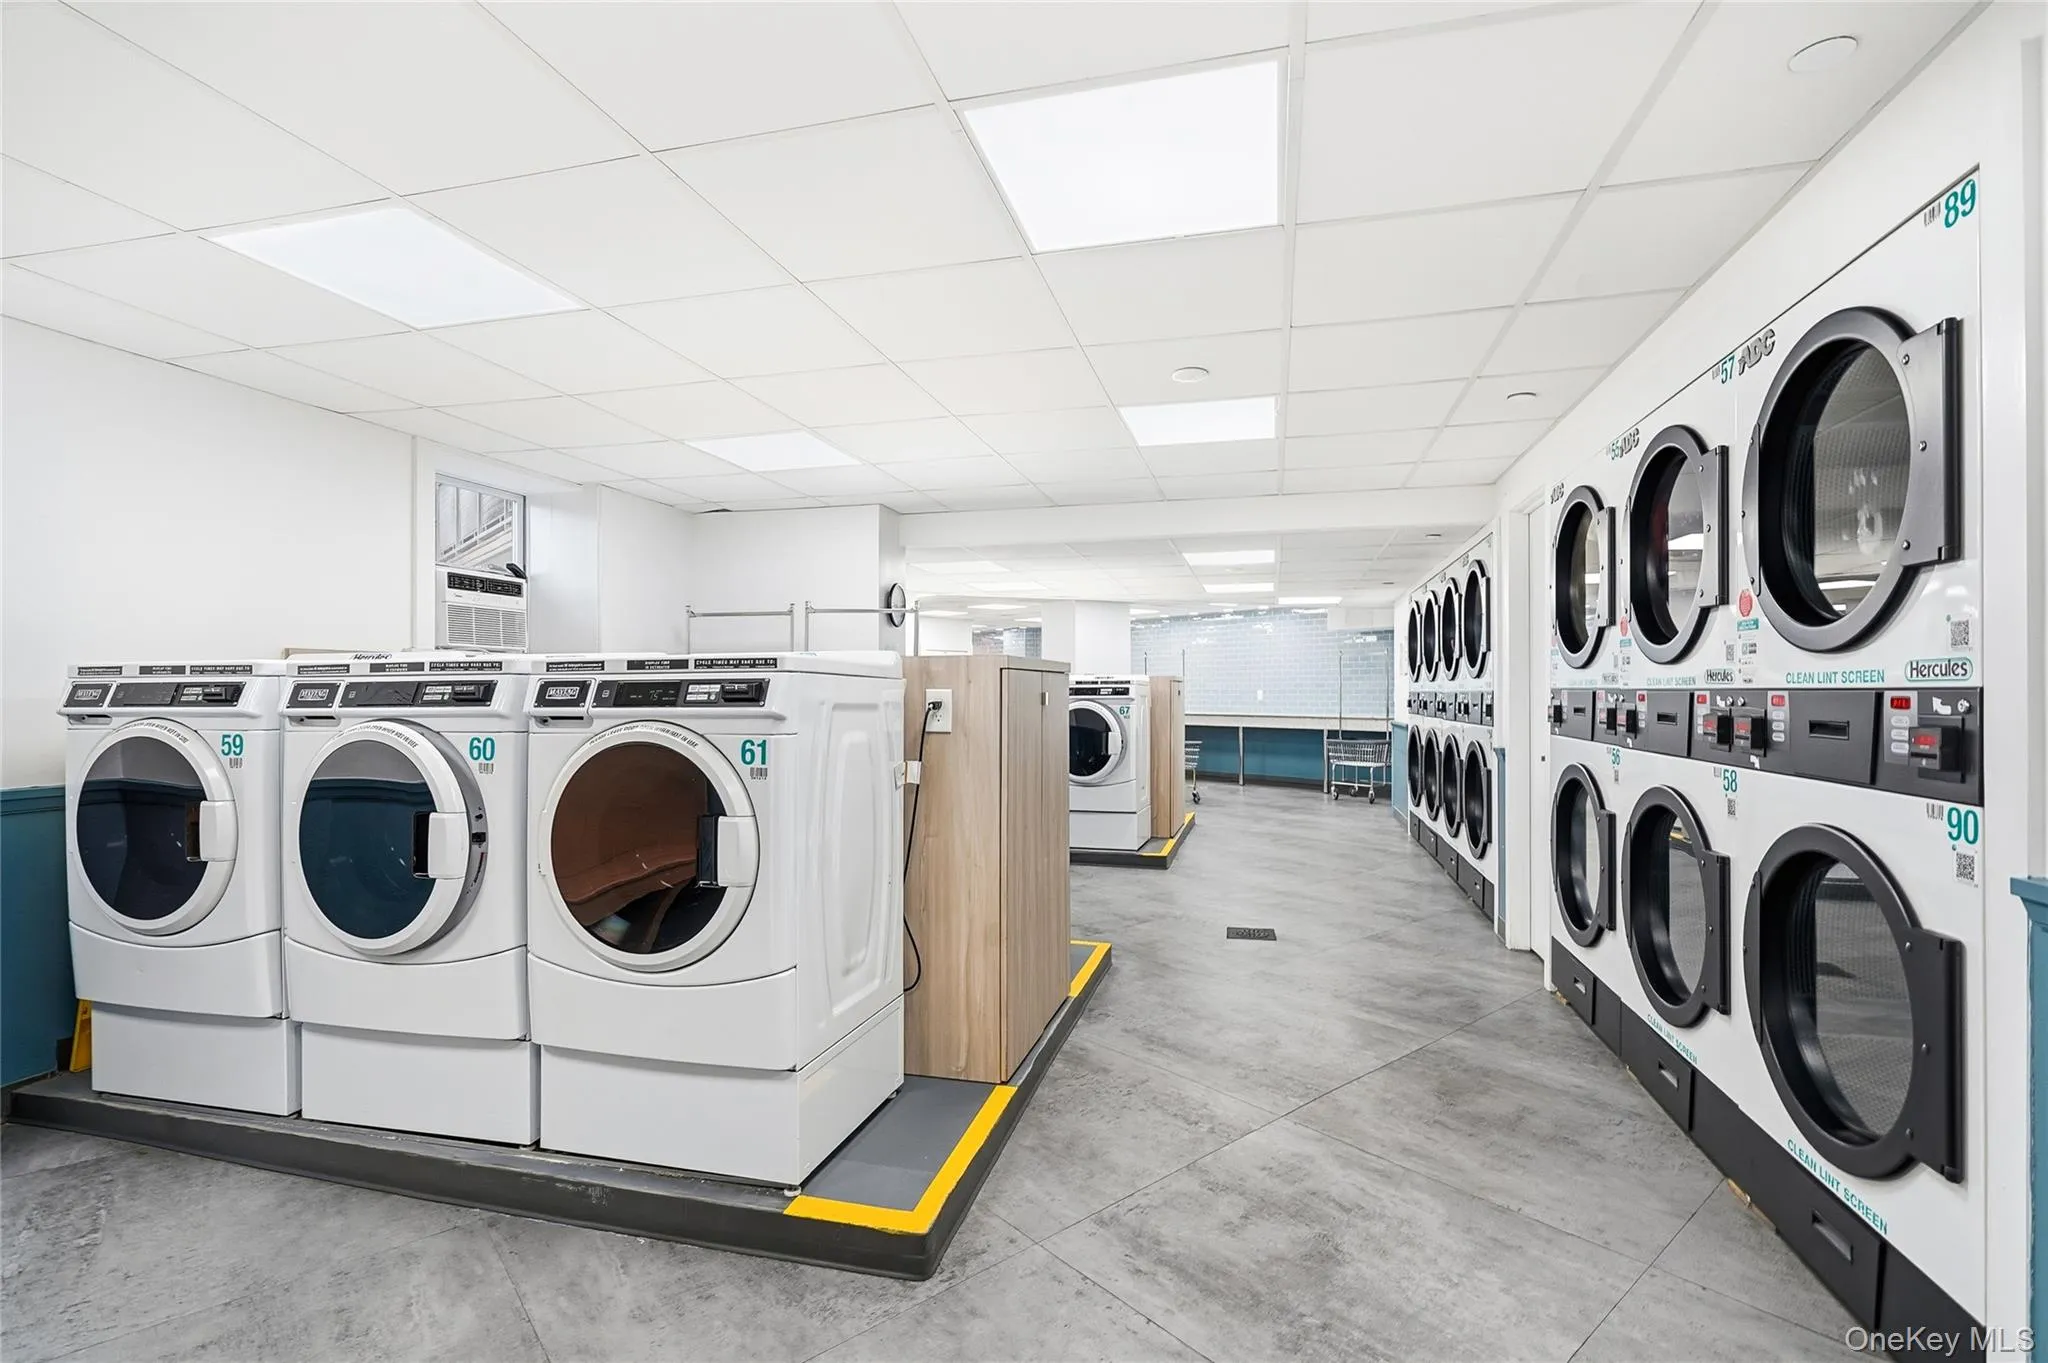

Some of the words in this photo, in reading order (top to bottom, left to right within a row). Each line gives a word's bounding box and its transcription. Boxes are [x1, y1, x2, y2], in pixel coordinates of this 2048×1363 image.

[1944, 178, 1977, 228] 89
[1721, 354, 1735, 384] 57
[1706, 669, 1734, 682] Hercules
[1785, 672, 1814, 684] CLEAN
[1817, 671, 1838, 684] LINT
[1841, 669, 1885, 684] SCREEN
[1910, 658, 1968, 679] Hercules
[1119, 706, 1131, 715] 67
[221, 734, 244, 757] 59
[469, 737, 496, 761] 60
[740, 739, 768, 766] 61
[1611, 748, 1621, 766] 56
[1723, 769, 1738, 792] 58
[1947, 806, 1979, 845] 90
[1787, 1139, 1817, 1172] CLEAN
[1819, 1165, 1841, 1192] LINT
[1843, 1187, 1888, 1235] SCREEN
